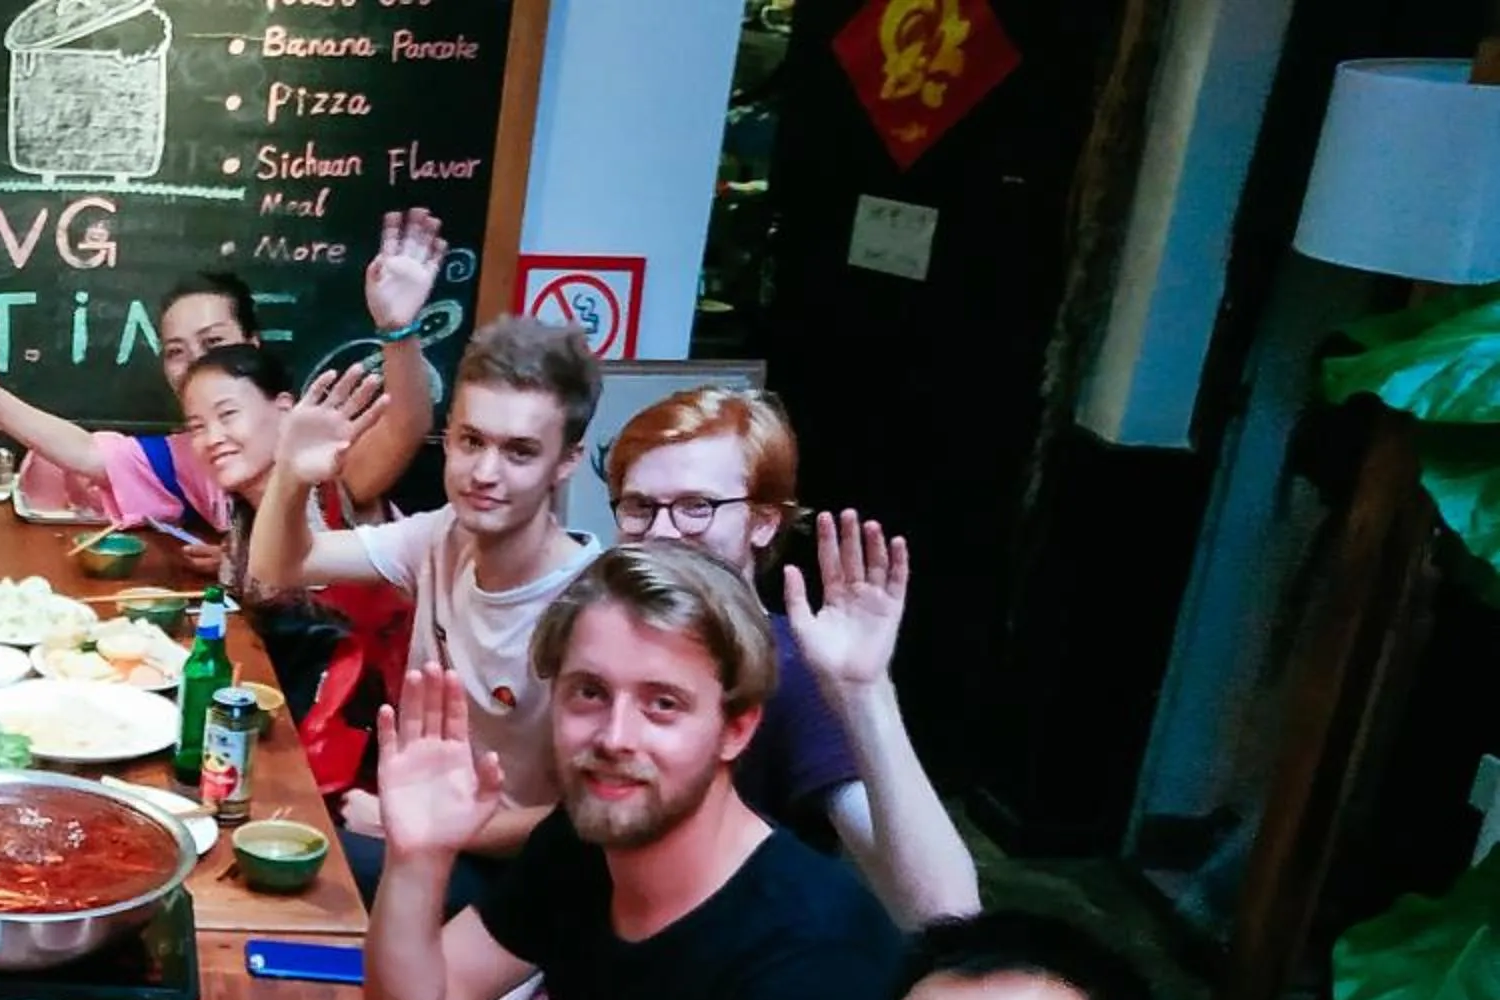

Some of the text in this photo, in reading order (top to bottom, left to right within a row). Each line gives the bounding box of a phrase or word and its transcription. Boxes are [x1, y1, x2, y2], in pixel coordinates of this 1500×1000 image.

[263, 26, 479, 63] Banana Pancake
[267, 81, 372, 124] Pizza
[256, 140, 482, 186] Sichuan Flavor
[259, 187, 331, 217] Meal
[253, 235, 348, 264] More
